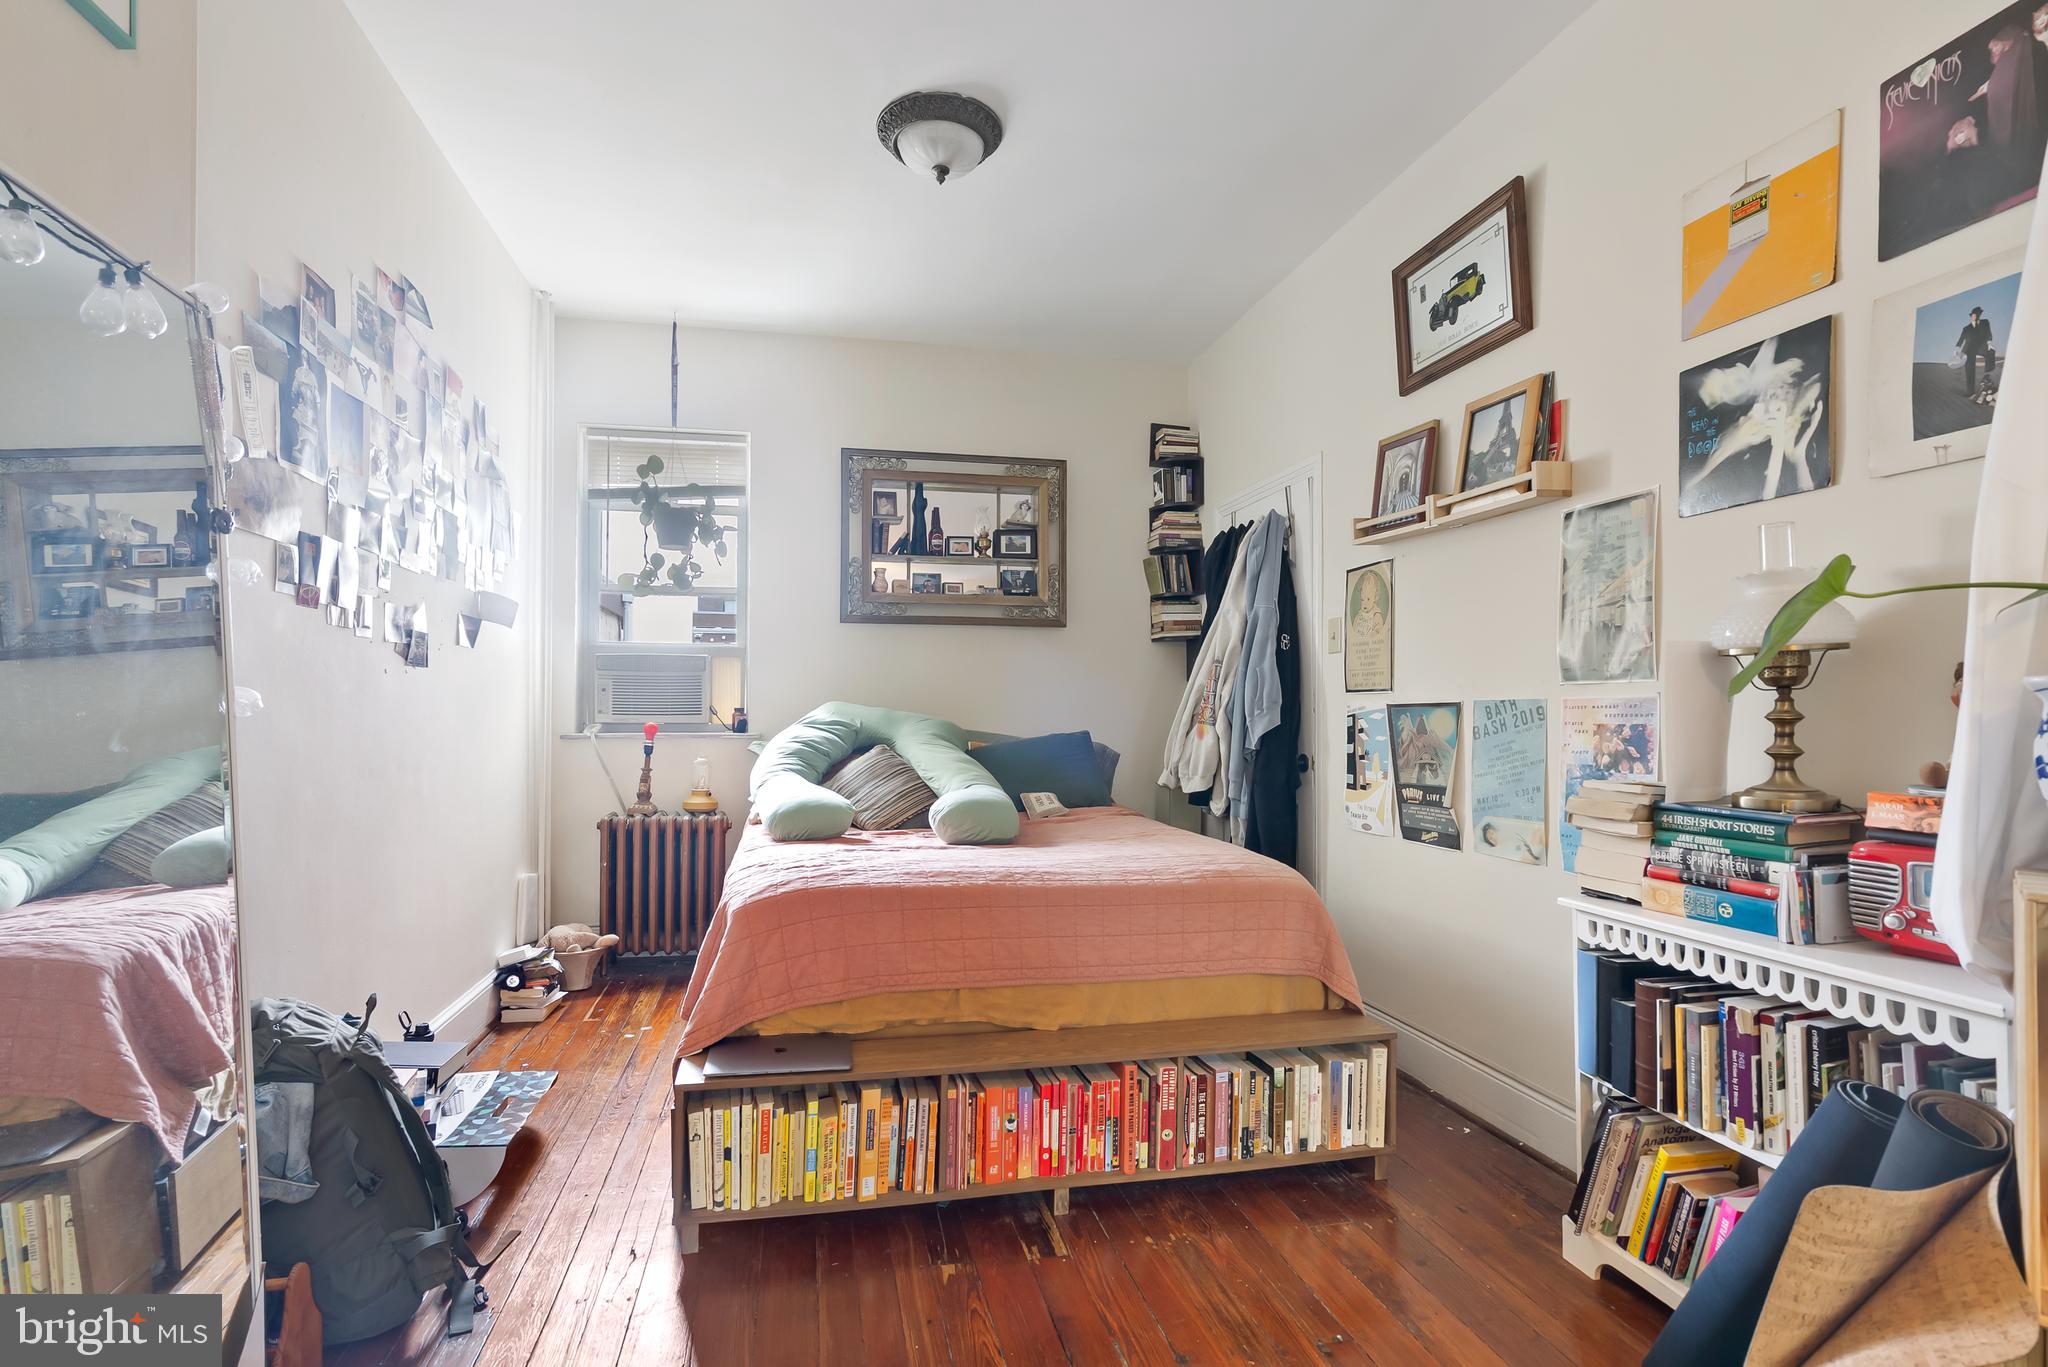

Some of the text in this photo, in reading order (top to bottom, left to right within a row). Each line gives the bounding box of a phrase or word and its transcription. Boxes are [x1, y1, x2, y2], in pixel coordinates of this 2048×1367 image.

[1691, 418, 1709, 434] HEAD
[1687, 437, 1719, 458] DOOR
[1484, 699, 1518, 721] BATH
[1473, 705, 1546, 740] BASH 2019
[1873, 801, 1904, 811] SARAH
[1661, 814, 1775, 836] 44 IRISH SHORT STORIES
[1877, 812, 1905, 820] MAAS
[1677, 834, 1723, 847] JANE GOODALL
[1655, 851, 1748, 872] BRUCE SPRINGSTEEN
[1811, 1050, 1820, 1070] theory
[1812, 1070, 1821, 1088] today
[762, 1110, 770, 1132] CLOUD
[1662, 1124, 1690, 1137] Yoga
[761, 1134, 770, 1153] ATLAS
[1641, 1135, 1697, 1148] Anatomy
